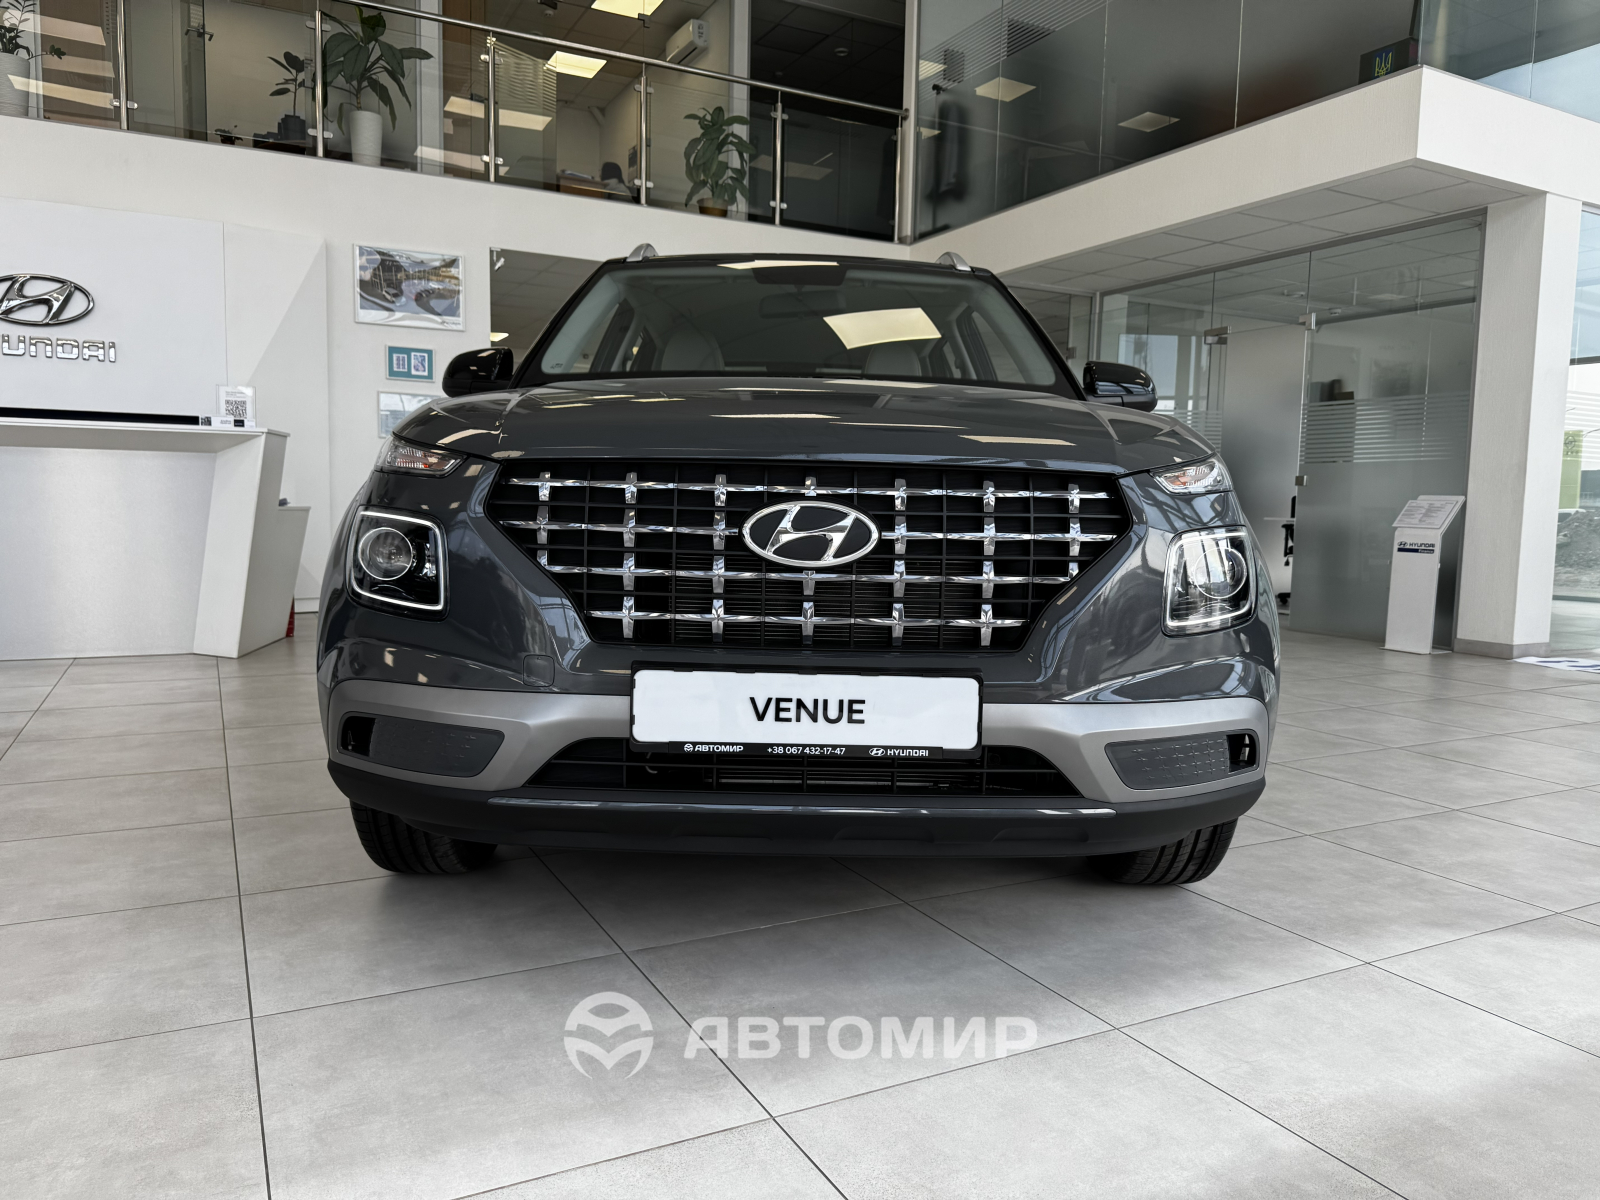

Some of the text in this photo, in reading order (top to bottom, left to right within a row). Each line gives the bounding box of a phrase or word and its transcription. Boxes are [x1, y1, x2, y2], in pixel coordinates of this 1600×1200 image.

[749, 696, 866, 724] VENUE
[694, 744, 744, 753] АВТОМИР
[766, 746, 846, 755] +38 067 432-17-47
[887, 748, 929, 757] HYUNDAI
